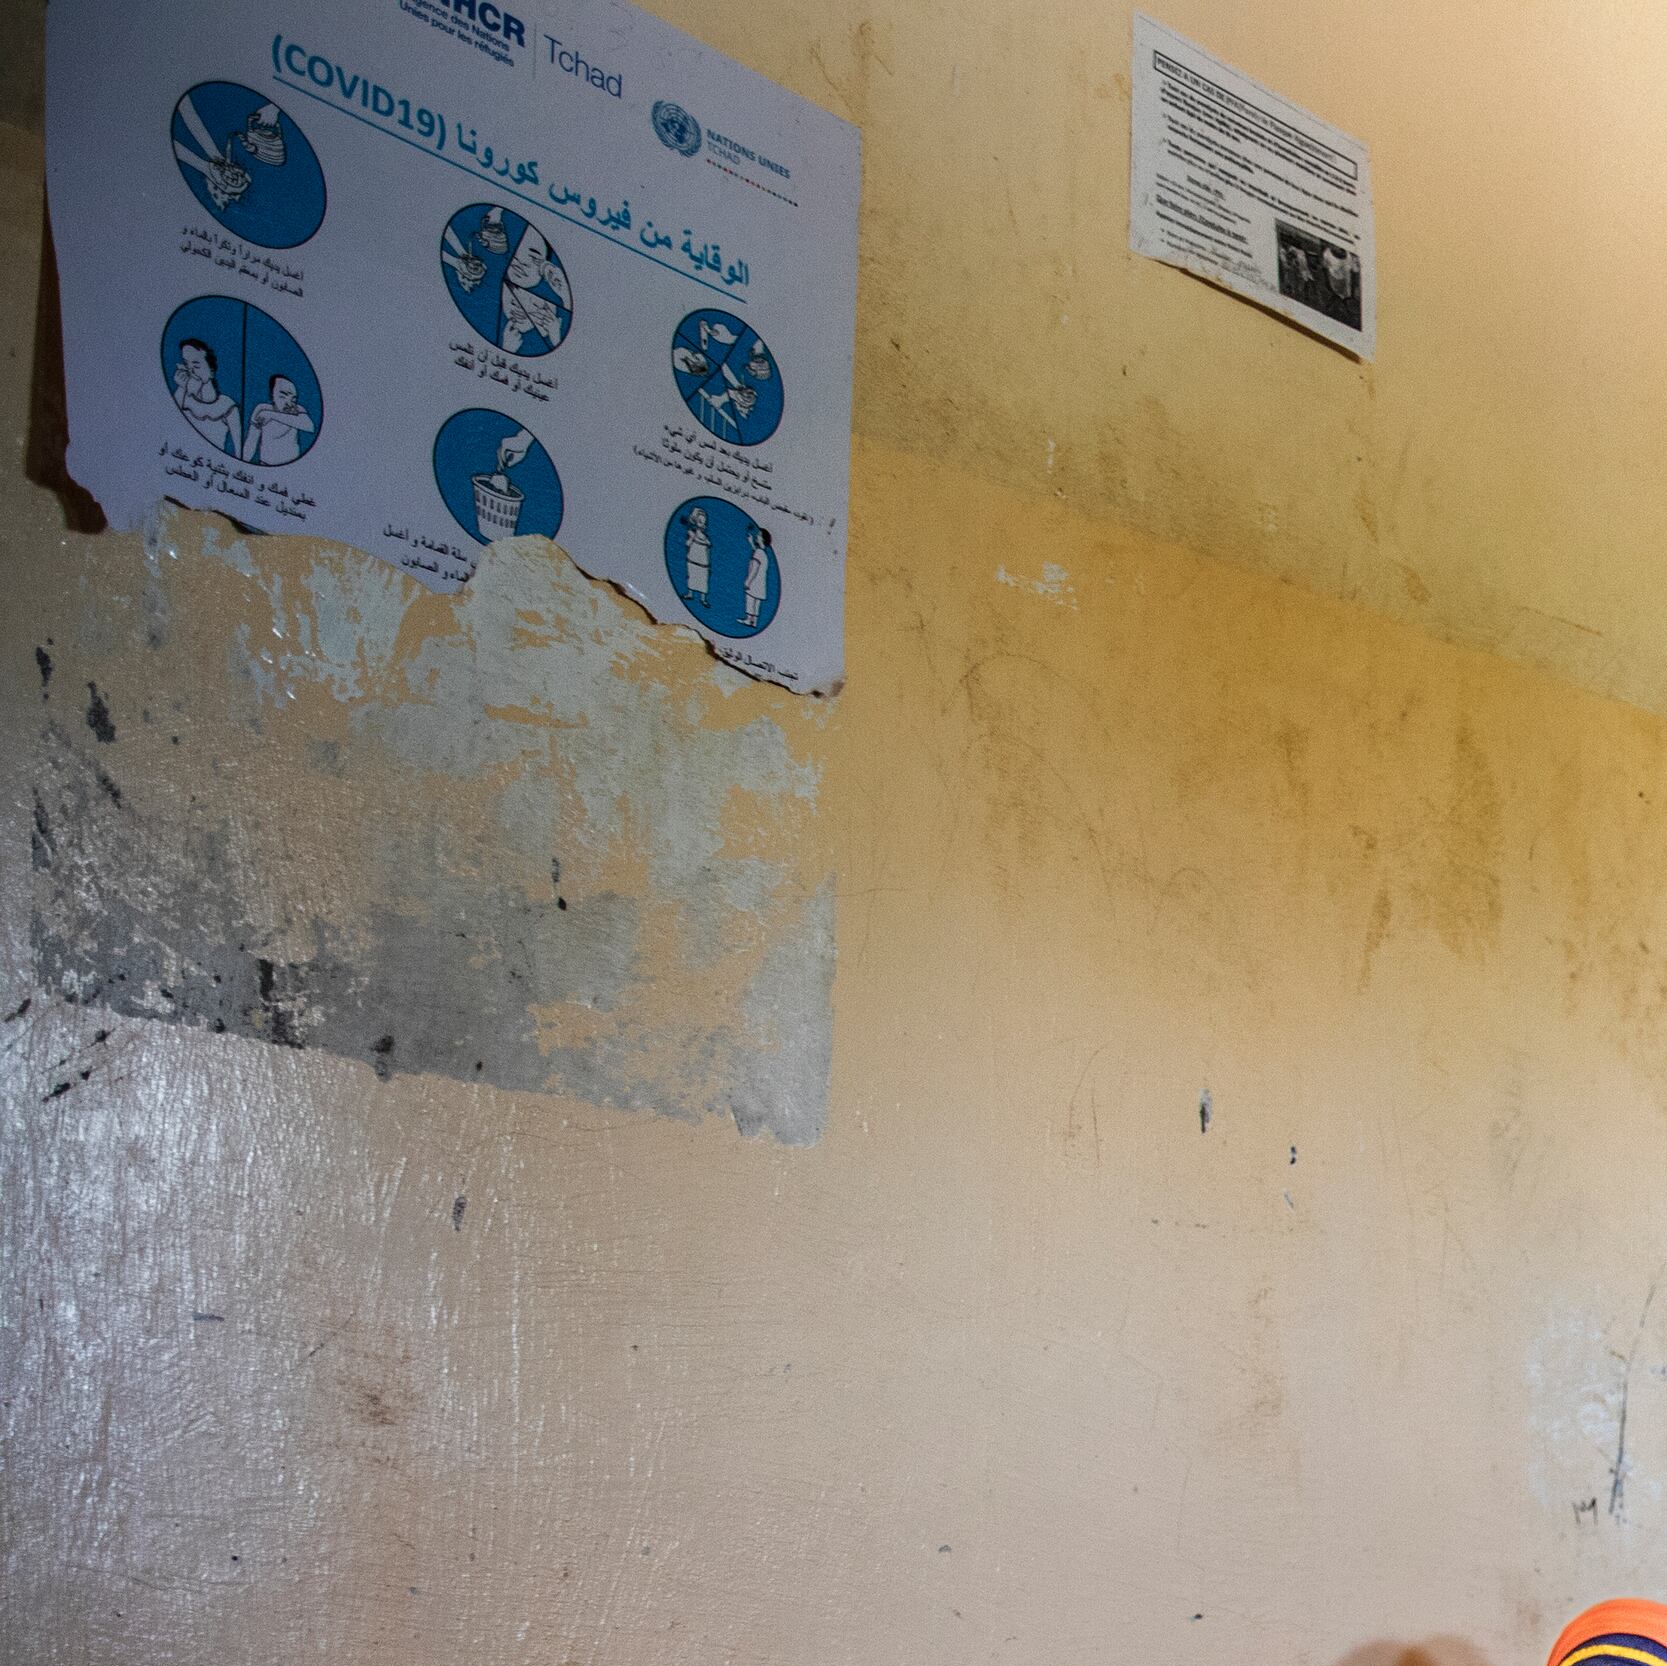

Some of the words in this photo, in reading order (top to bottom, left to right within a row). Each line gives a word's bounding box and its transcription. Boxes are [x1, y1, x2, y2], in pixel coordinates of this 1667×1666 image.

[400, 2, 430, 23] Unies
[431, 19, 455, 36] pour
[457, 29, 473, 45] les
[474, 41, 515, 67] réfugiés
[415, 0, 449, 20] gence
[471, 24, 510, 52] Nations
[441, 0, 525, 48] HCR
[271, 33, 447, 151] (COVID19)
[543, 34, 622, 99] Tchad
[456, 123, 540, 186] كورونا
[706, 128, 757, 163] NATIONS
[757, 154, 791, 180] UNIES
[549, 182, 632, 230] فيروس
[640, 220, 673, 250] من
[681, 229, 750, 287] الوقاية
